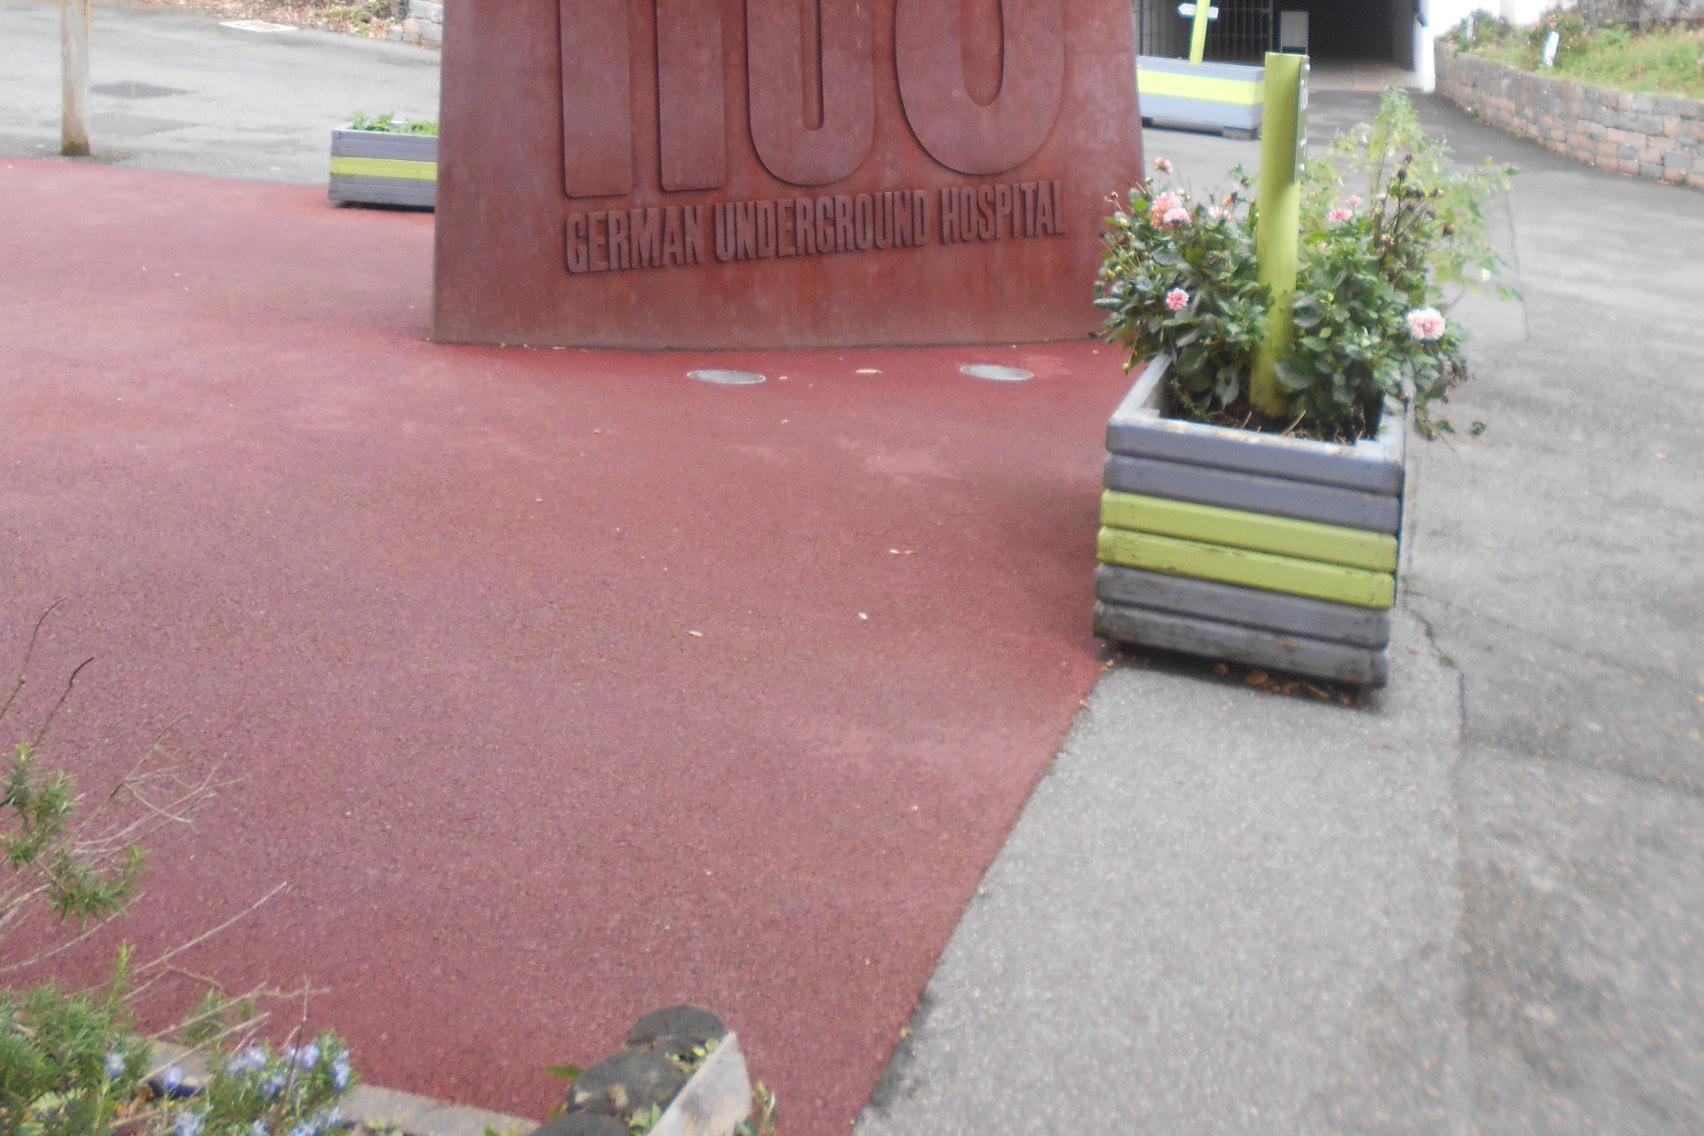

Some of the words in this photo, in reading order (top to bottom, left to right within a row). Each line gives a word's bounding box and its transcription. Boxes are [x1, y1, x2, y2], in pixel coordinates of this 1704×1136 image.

[565, 205, 704, 274] GERMAN
[714, 189, 931, 263] UNDERGROUND
[939, 180, 1065, 245] HOSPITAL
